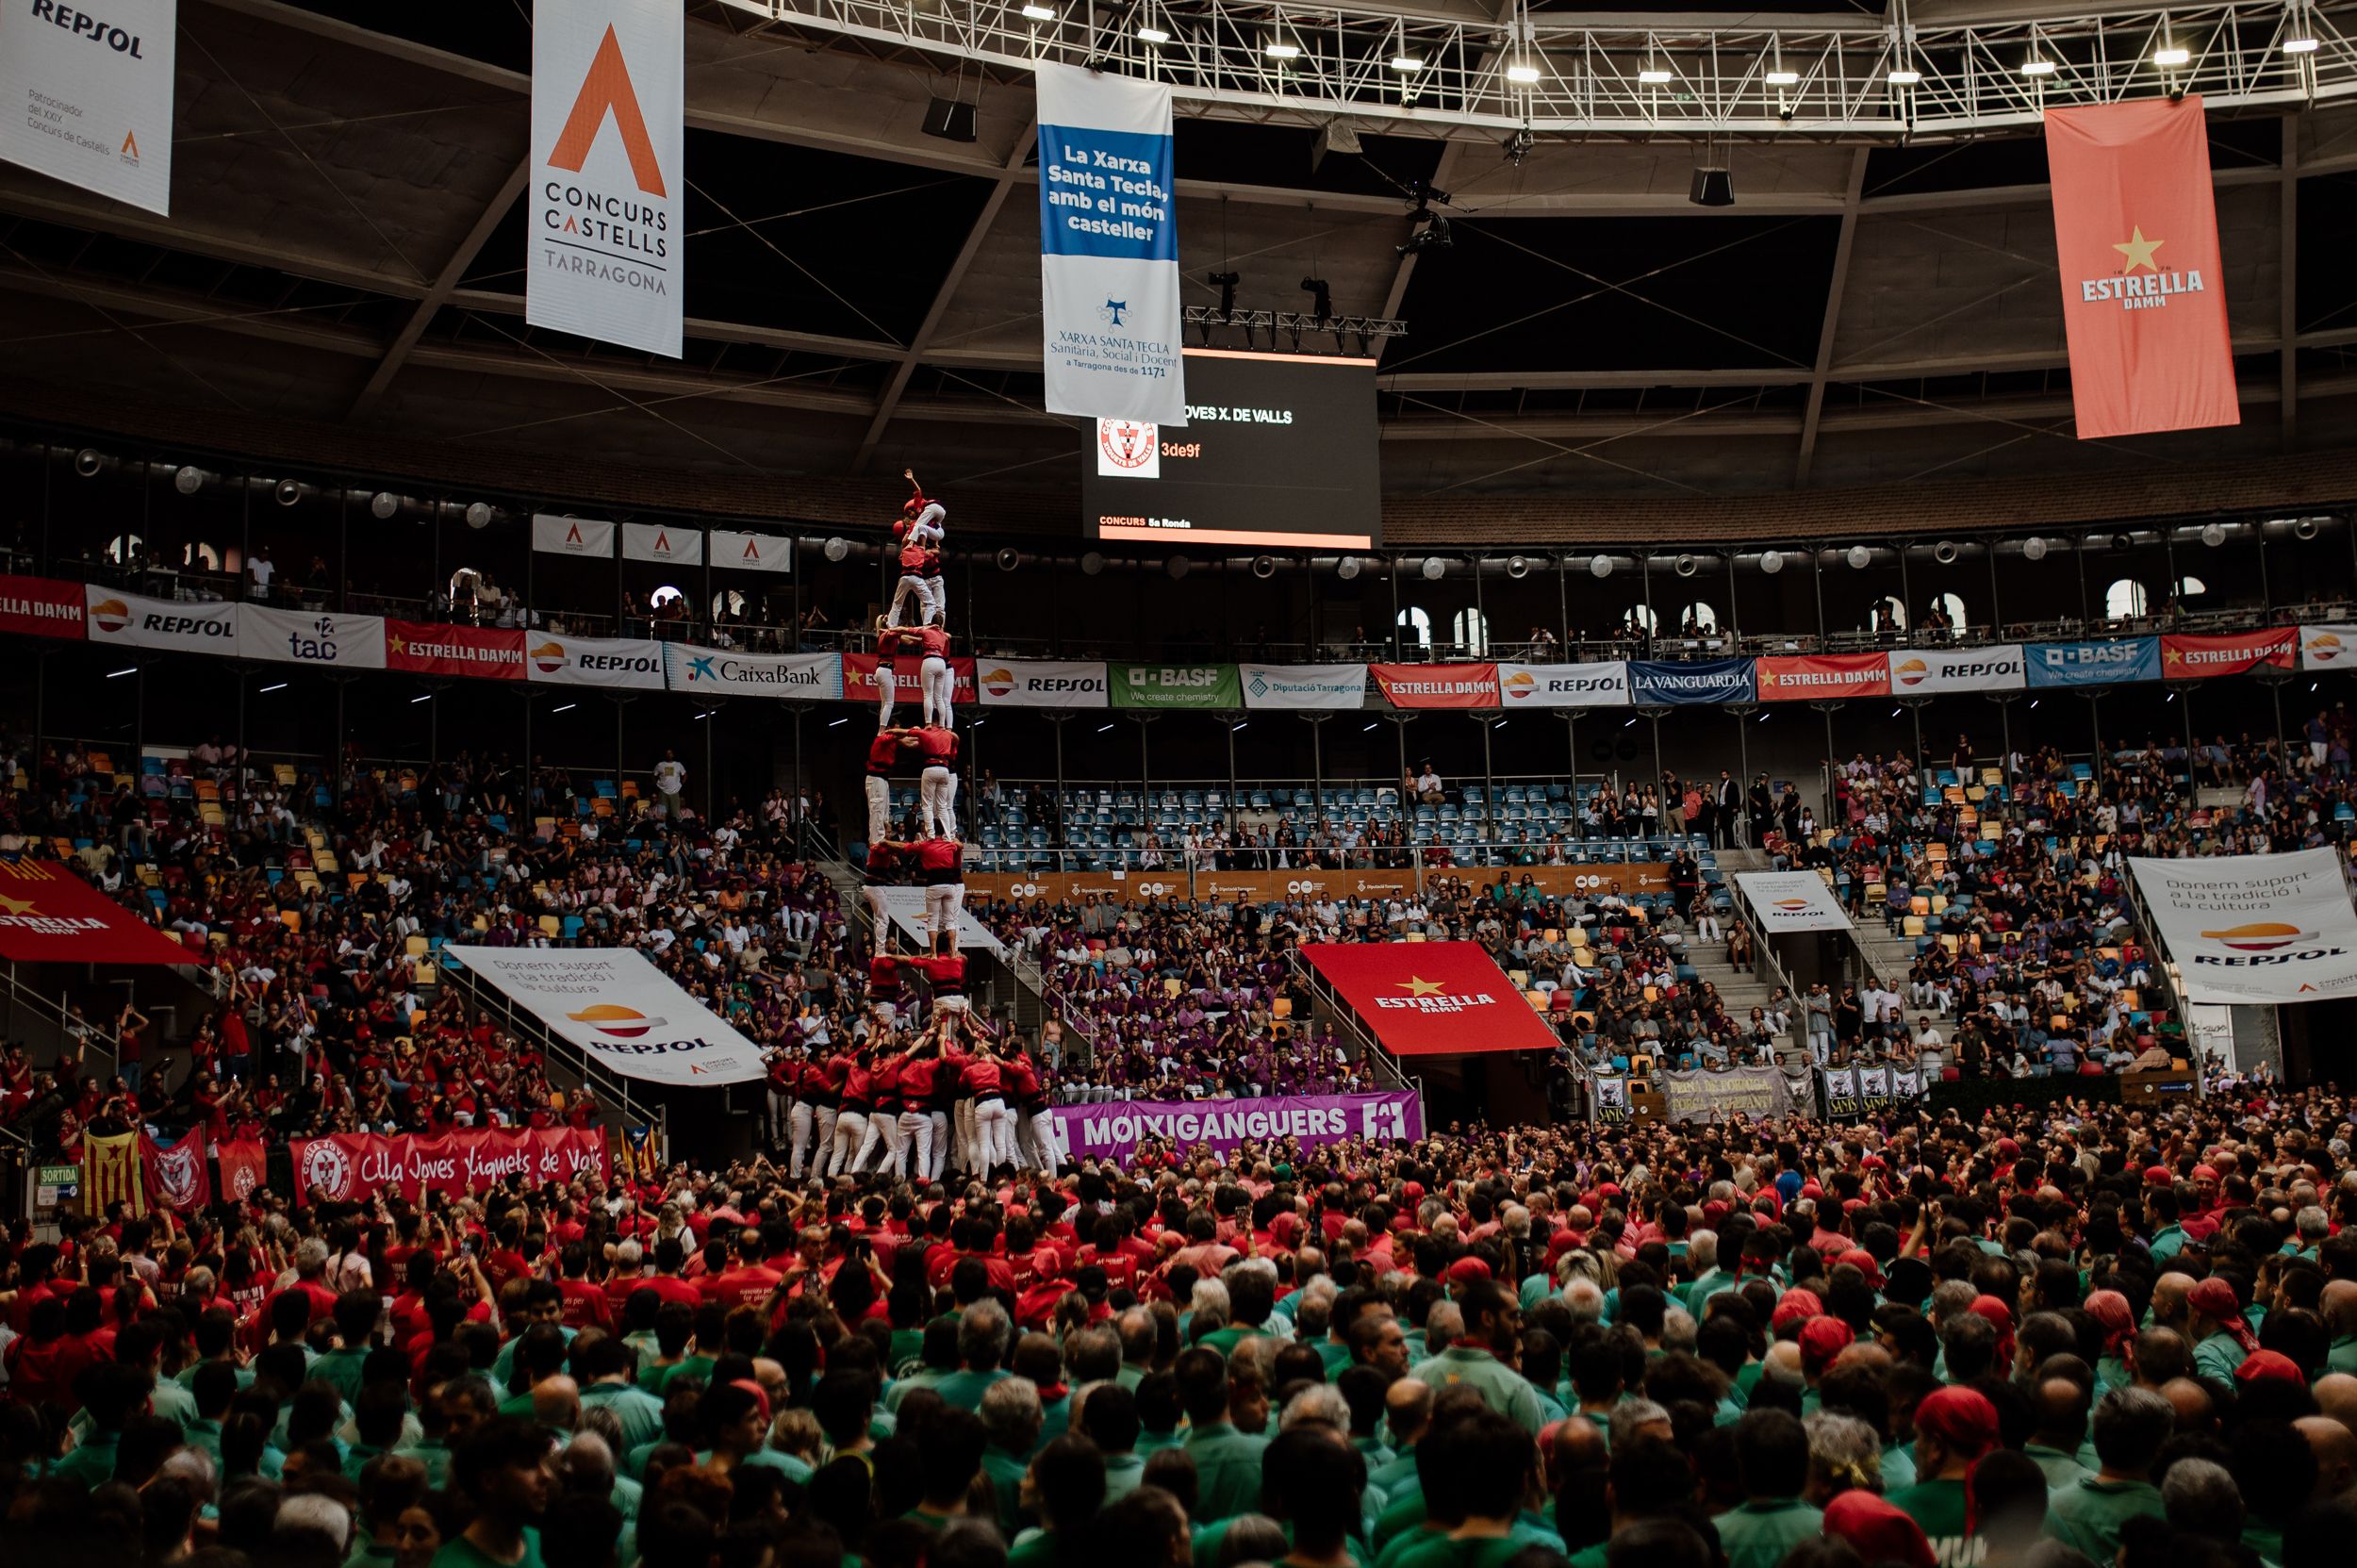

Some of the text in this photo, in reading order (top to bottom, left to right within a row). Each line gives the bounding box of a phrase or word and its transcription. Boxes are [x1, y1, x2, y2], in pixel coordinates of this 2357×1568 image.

[32, 0, 142, 59] REPSOL
[29, 89, 83, 118] Patrocinador
[28, 104, 62, 124] del XXIX
[27, 117, 110, 156] Concurs de Castells
[1064, 145, 1151, 174] La Xarxa
[1048, 165, 1168, 203] Santa Tecla,
[545, 182, 667, 231] CONCURS
[1048, 190, 1165, 222] amb el món
[545, 209, 667, 257] CASTELLS
[1068, 216, 1153, 241] casteller
[544, 249, 667, 296] TARRAGONA
[2081, 270, 2203, 303] ESTRELLA
[2123, 295, 2167, 310] DAMM
[1060, 330, 1169, 355] XARXA SANTA TECLA
[1050, 342, 1099, 358] Sanitària,
[1103, 348, 1131, 362] Social
[1142, 354, 1177, 369] Docent
[1073, 359, 1112, 371] Tarragona
[1114, 365, 1127, 373] des
[1141, 367, 1165, 379] 1171
[1185, 405, 1293, 424] OVES X. DE VALLS
[1161, 442, 1201, 458] 3de9f
[1099, 516, 1146, 527] CONCURS
[1162, 519, 1192, 529] Ronda
[34, 602, 82, 621] DAMM
[143, 614, 234, 637] REPSOL
[288, 631, 337, 660] tac
[409, 642, 523, 664] ESTRELLA DAMM
[2078, 643, 2138, 664] BASF
[2185, 642, 2293, 665] ESTRELLA DAM
[579, 654, 660, 672] REPSOL
[1941, 661, 2021, 679] REPSOL
[720, 661, 821, 685] CaixaBank
[1161, 668, 1217, 686] BASF
[1635, 674, 1751, 689] LA VANGUARDIA
[1779, 669, 1887, 686] ESTRELLA DAMM
[2048, 666, 2142, 680] We create chemistry
[1028, 678, 1105, 692] REPSOL
[1273, 683, 1361, 695] Diputació Tarragona
[1391, 681, 1495, 695] ESTRELLA DAMM
[1549, 677, 1624, 692] REPSOL
[1131, 691, 1220, 703] We create chemistry
[2167, 871, 2312, 890] Donem suport
[2187, 891, 2206, 900] la
[2212, 887, 2289, 900] tradició
[2295, 884, 2301, 895] i
[2172, 900, 2270, 911] la cultura
[31, 927, 80, 935] DAMM
[493, 960, 616, 972] Donem suport
[2195, 948, 2348, 966] REPSOL
[507, 971, 615, 982] a la tradició i
[517, 982, 600, 994] la cultura
[1375, 994, 1496, 1009] ESTRELLA
[1420, 1006, 1463, 1015] DAMM
[589, 1037, 715, 1055] REPSOL
[1598, 1107, 1625, 1123] SANTS
[1830, 1098, 1857, 1114] SANTS
[1083, 1108, 1347, 1147] MOIXIGANGUERS
[304, 1141, 349, 1175] COLLA JOVES
[409, 1151, 455, 1180] Joves
[539, 1147, 560, 1173] de
[41, 1168, 76, 1183] SORTIDA
